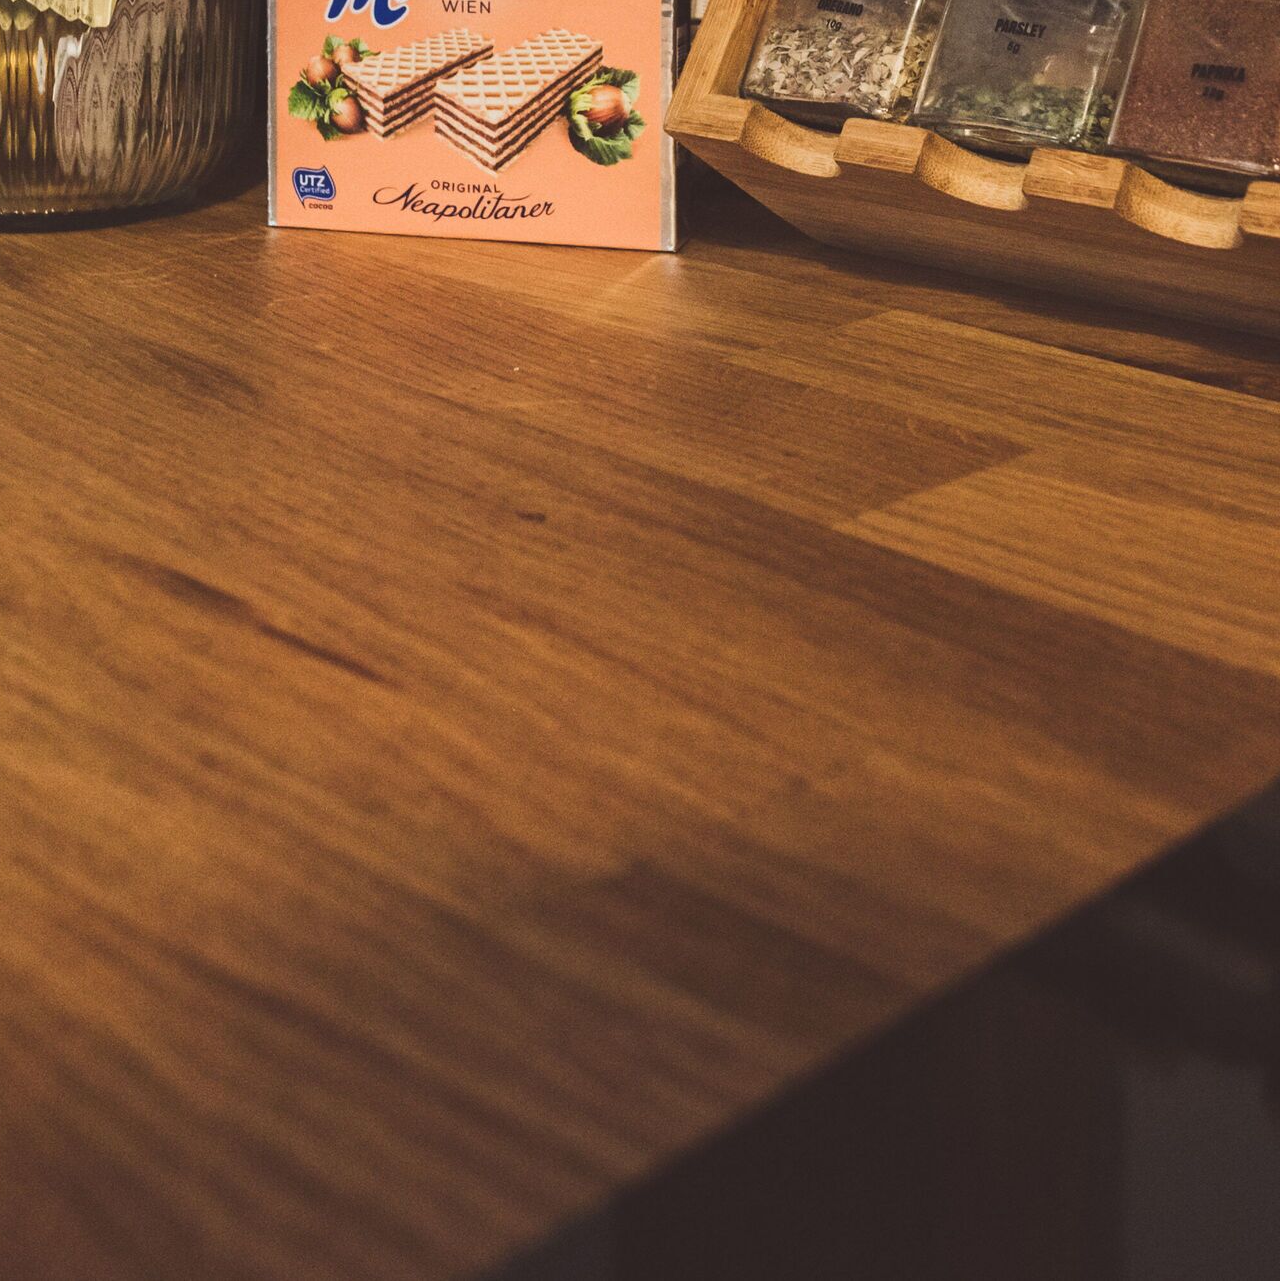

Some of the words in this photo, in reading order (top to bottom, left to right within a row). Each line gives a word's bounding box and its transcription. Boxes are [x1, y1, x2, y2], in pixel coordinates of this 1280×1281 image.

[441, 0, 492, 14] WIEN
[826, 18, 842, 32] 10g
[994, 17, 1047, 38] PARSLEY
[1191, 63, 1245, 82] PAPRIKA
[299, 174, 325, 187] UTZ
[430, 179, 502, 194] ORIGINAL
[299, 185, 331, 195] Certified
[308, 202, 334, 210] cocoa
[372, 182, 556, 222] Neapolitaner
